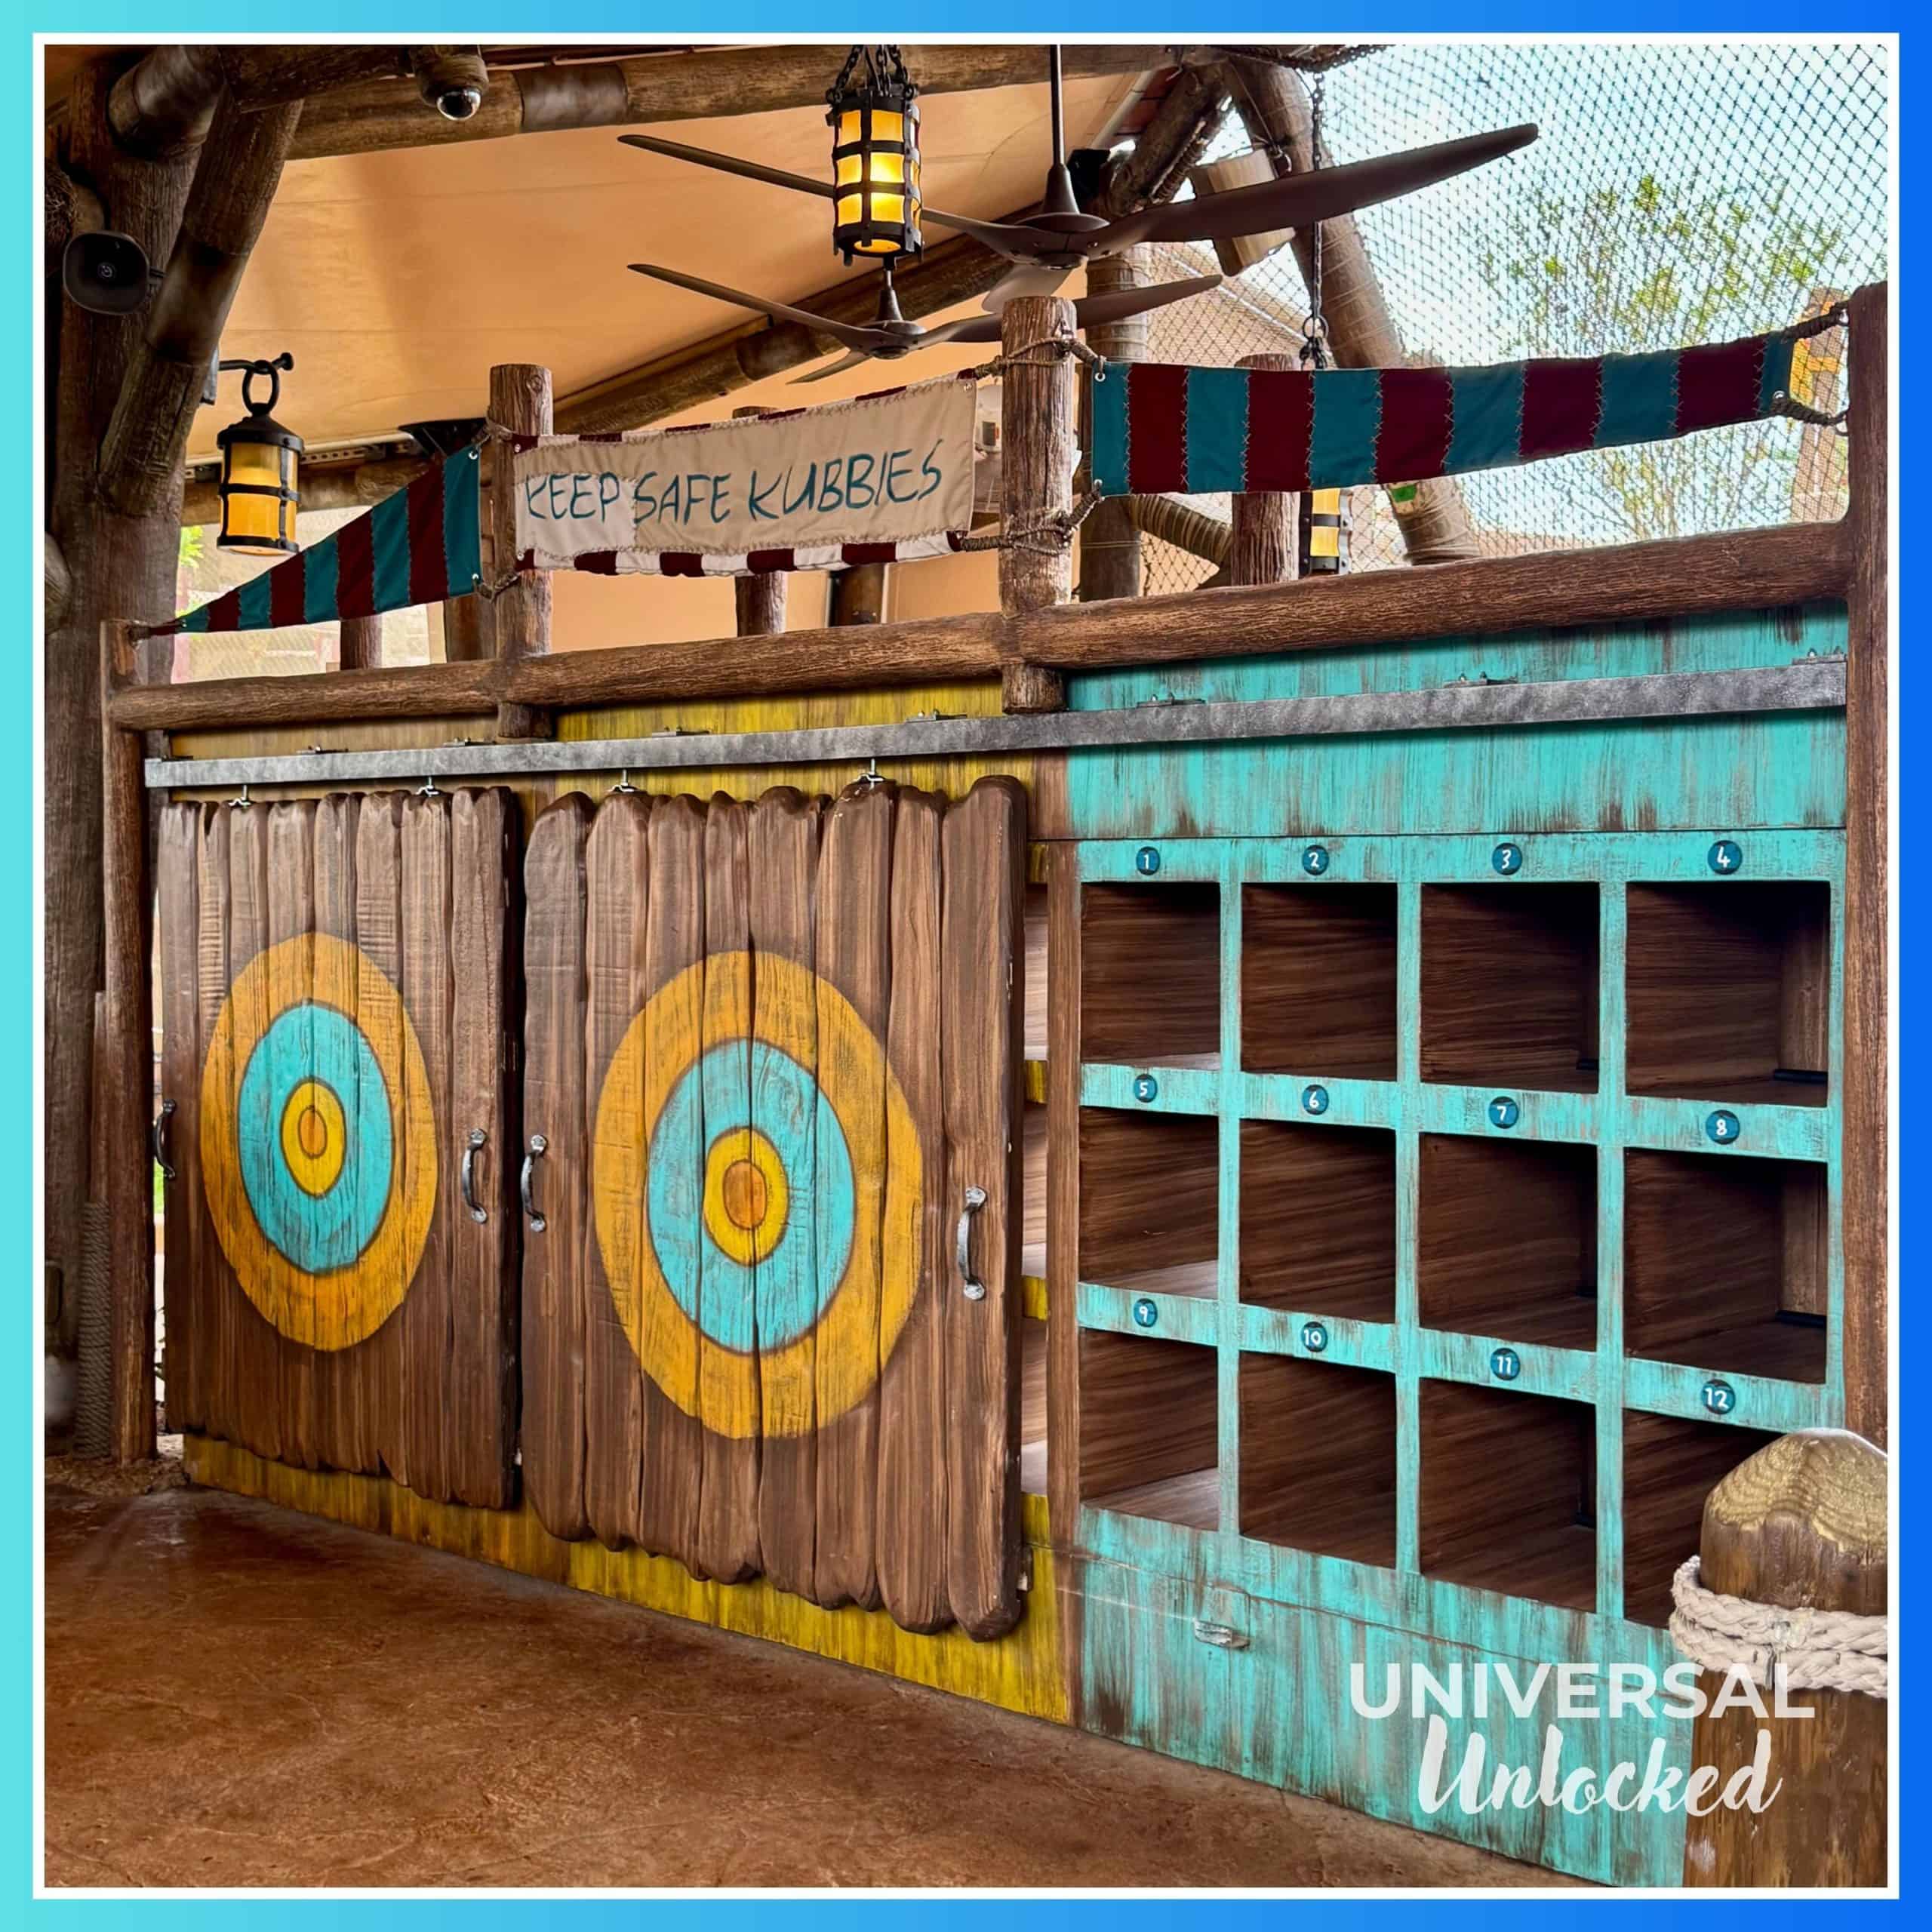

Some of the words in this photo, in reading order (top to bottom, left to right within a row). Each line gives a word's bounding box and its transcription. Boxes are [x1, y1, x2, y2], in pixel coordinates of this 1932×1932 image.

[526, 470, 620, 521] KEEP
[633, 470, 732, 525] SAFE
[748, 438, 943, 521] KUBBIES
[1144, 854, 1149, 869] 1
[1309, 851, 1319, 868] 2
[1501, 850, 1512, 869] 3
[1717, 846, 1730, 868] 4
[1140, 1081, 1148, 1097] 5
[1309, 1091, 1320, 1108] 6
[1497, 1105, 1506, 1121] 7
[1716, 1118, 1727, 1136] 8
[1140, 1306, 1149, 1323] 9
[1303, 1328, 1322, 1346] 10
[1497, 1355, 1512, 1374] 11
[1704, 1387, 1729, 1409] 12
